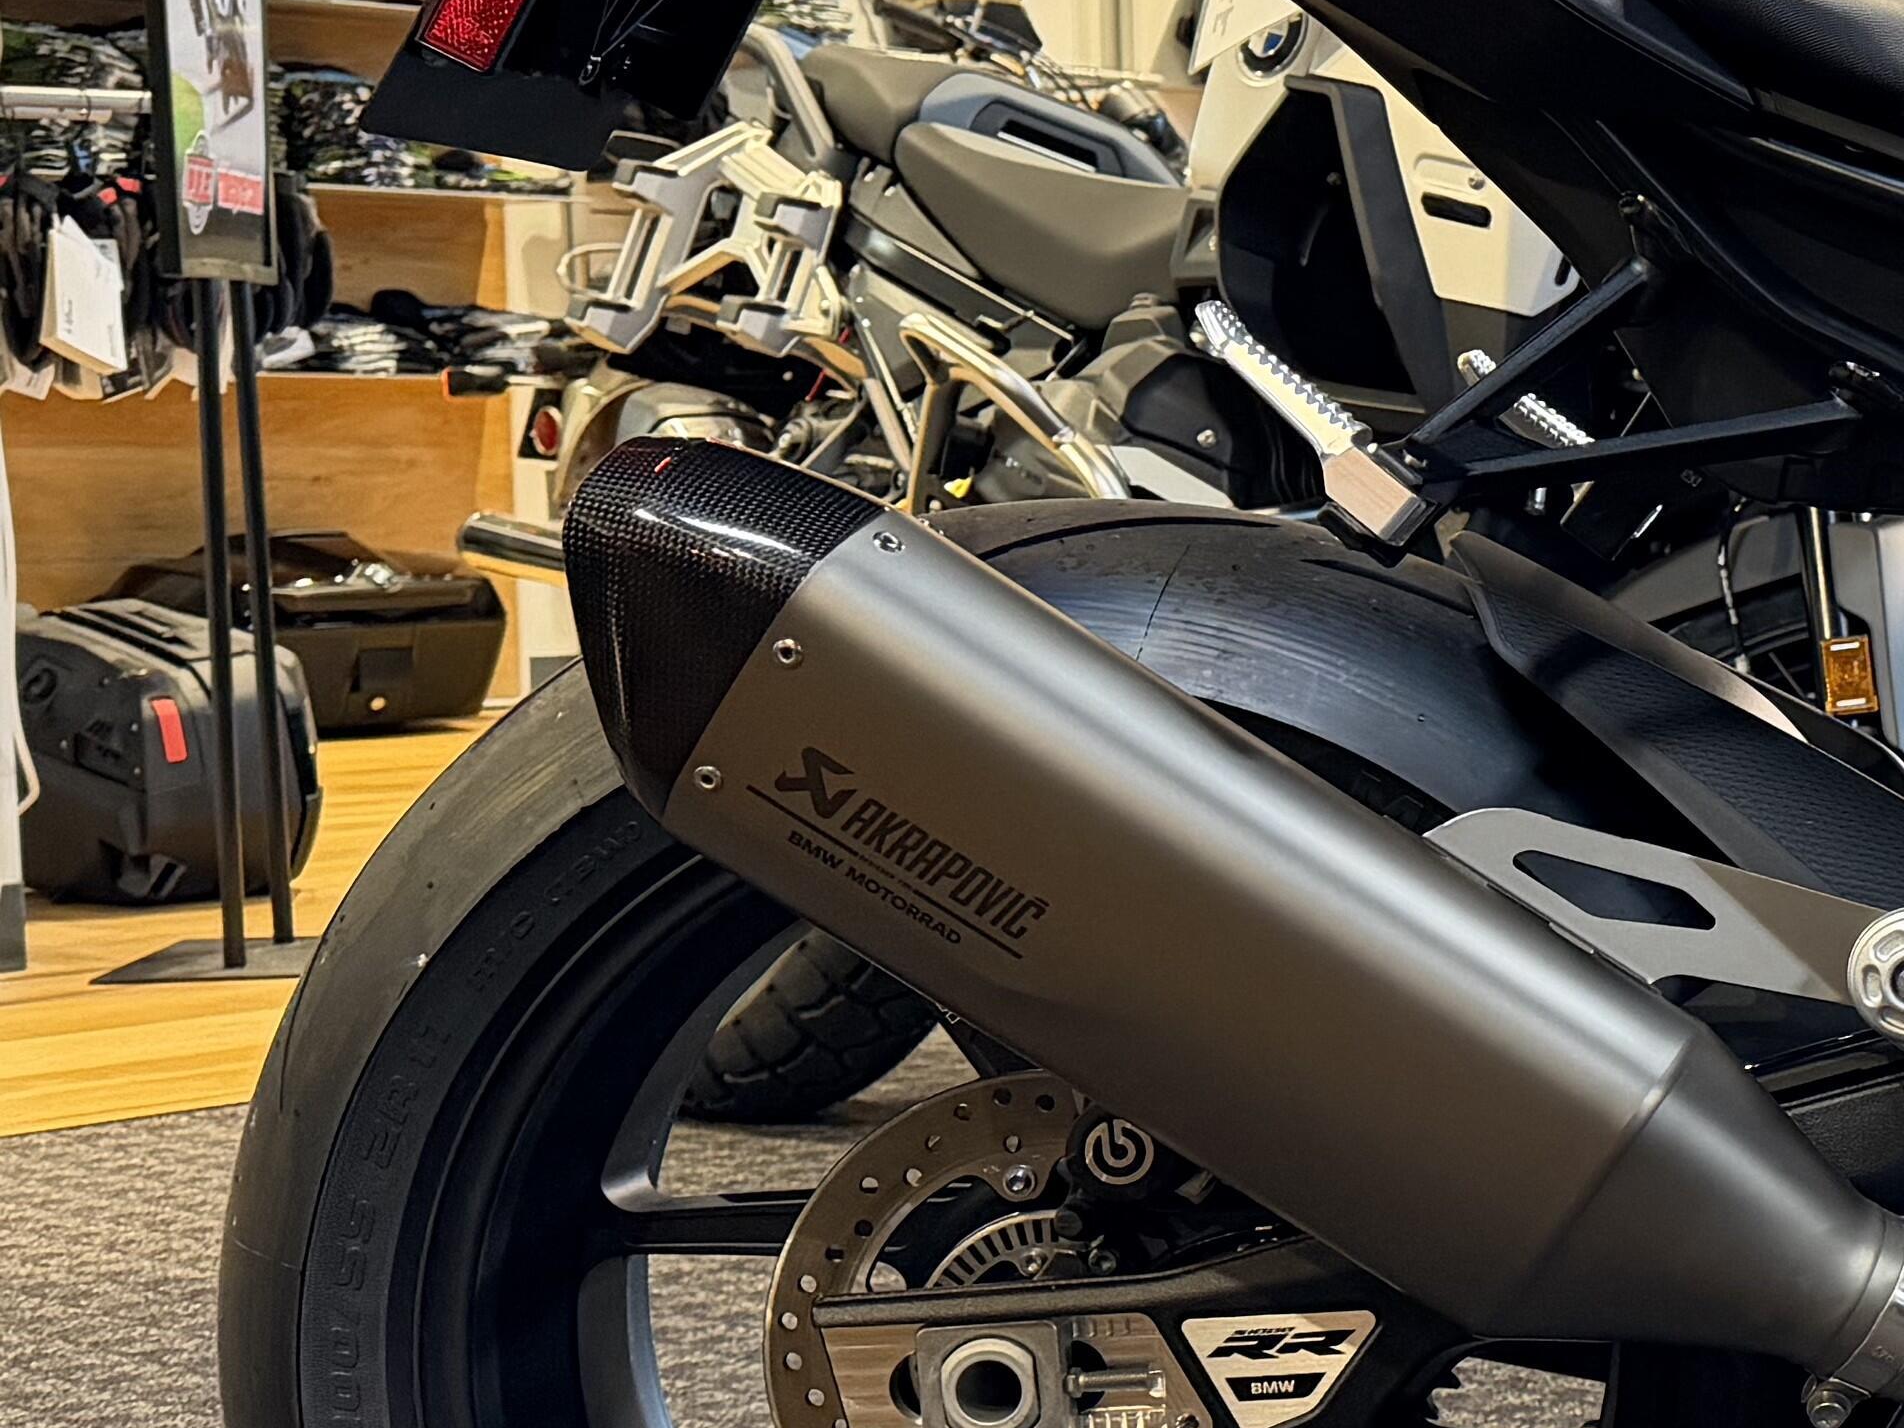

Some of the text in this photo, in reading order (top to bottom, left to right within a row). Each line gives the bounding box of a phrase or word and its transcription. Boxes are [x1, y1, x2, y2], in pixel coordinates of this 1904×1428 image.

[787, 828, 844, 870] BMW
[844, 866, 962, 946] MOTORRAD
[1206, 1329, 1357, 1360] RR
[1250, 1380, 1295, 1395] BMW
